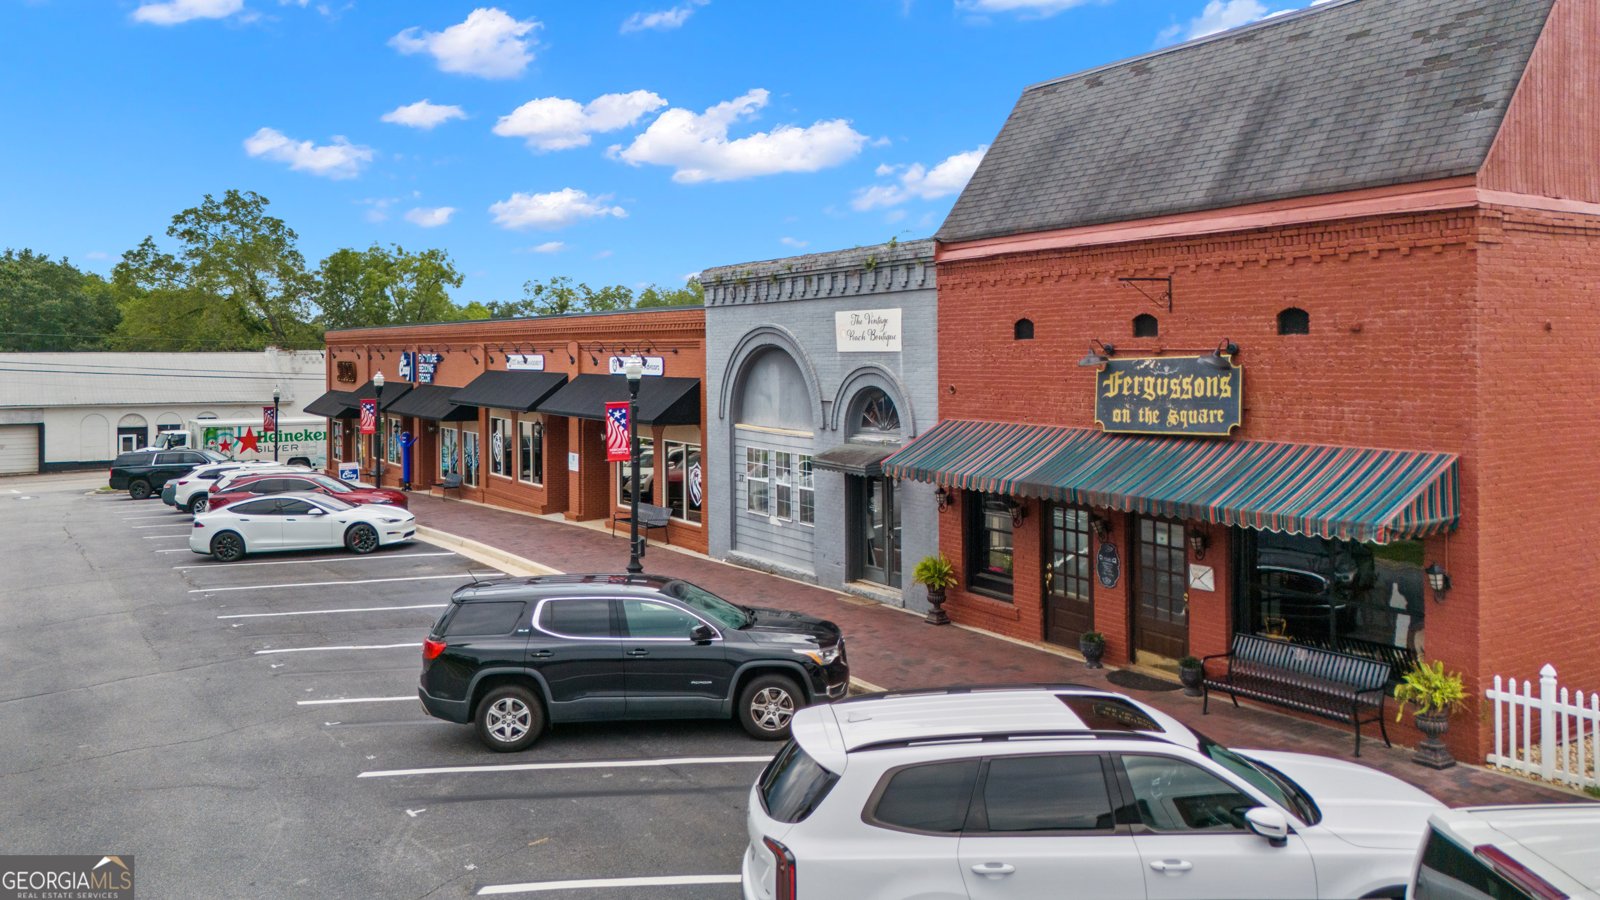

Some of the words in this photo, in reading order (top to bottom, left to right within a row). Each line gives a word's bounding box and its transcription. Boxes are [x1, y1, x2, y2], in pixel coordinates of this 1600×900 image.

[850, 314, 863, 326] The
[864, 312, 888, 332] Vintage
[846, 329, 866, 341] Peach
[866, 328, 896, 347] Boutique
[1112, 409, 1131, 424] on
[1138, 407, 1160, 425] the
[1166, 407, 1224, 430] Square
[257, 444, 299, 453] SILVER
